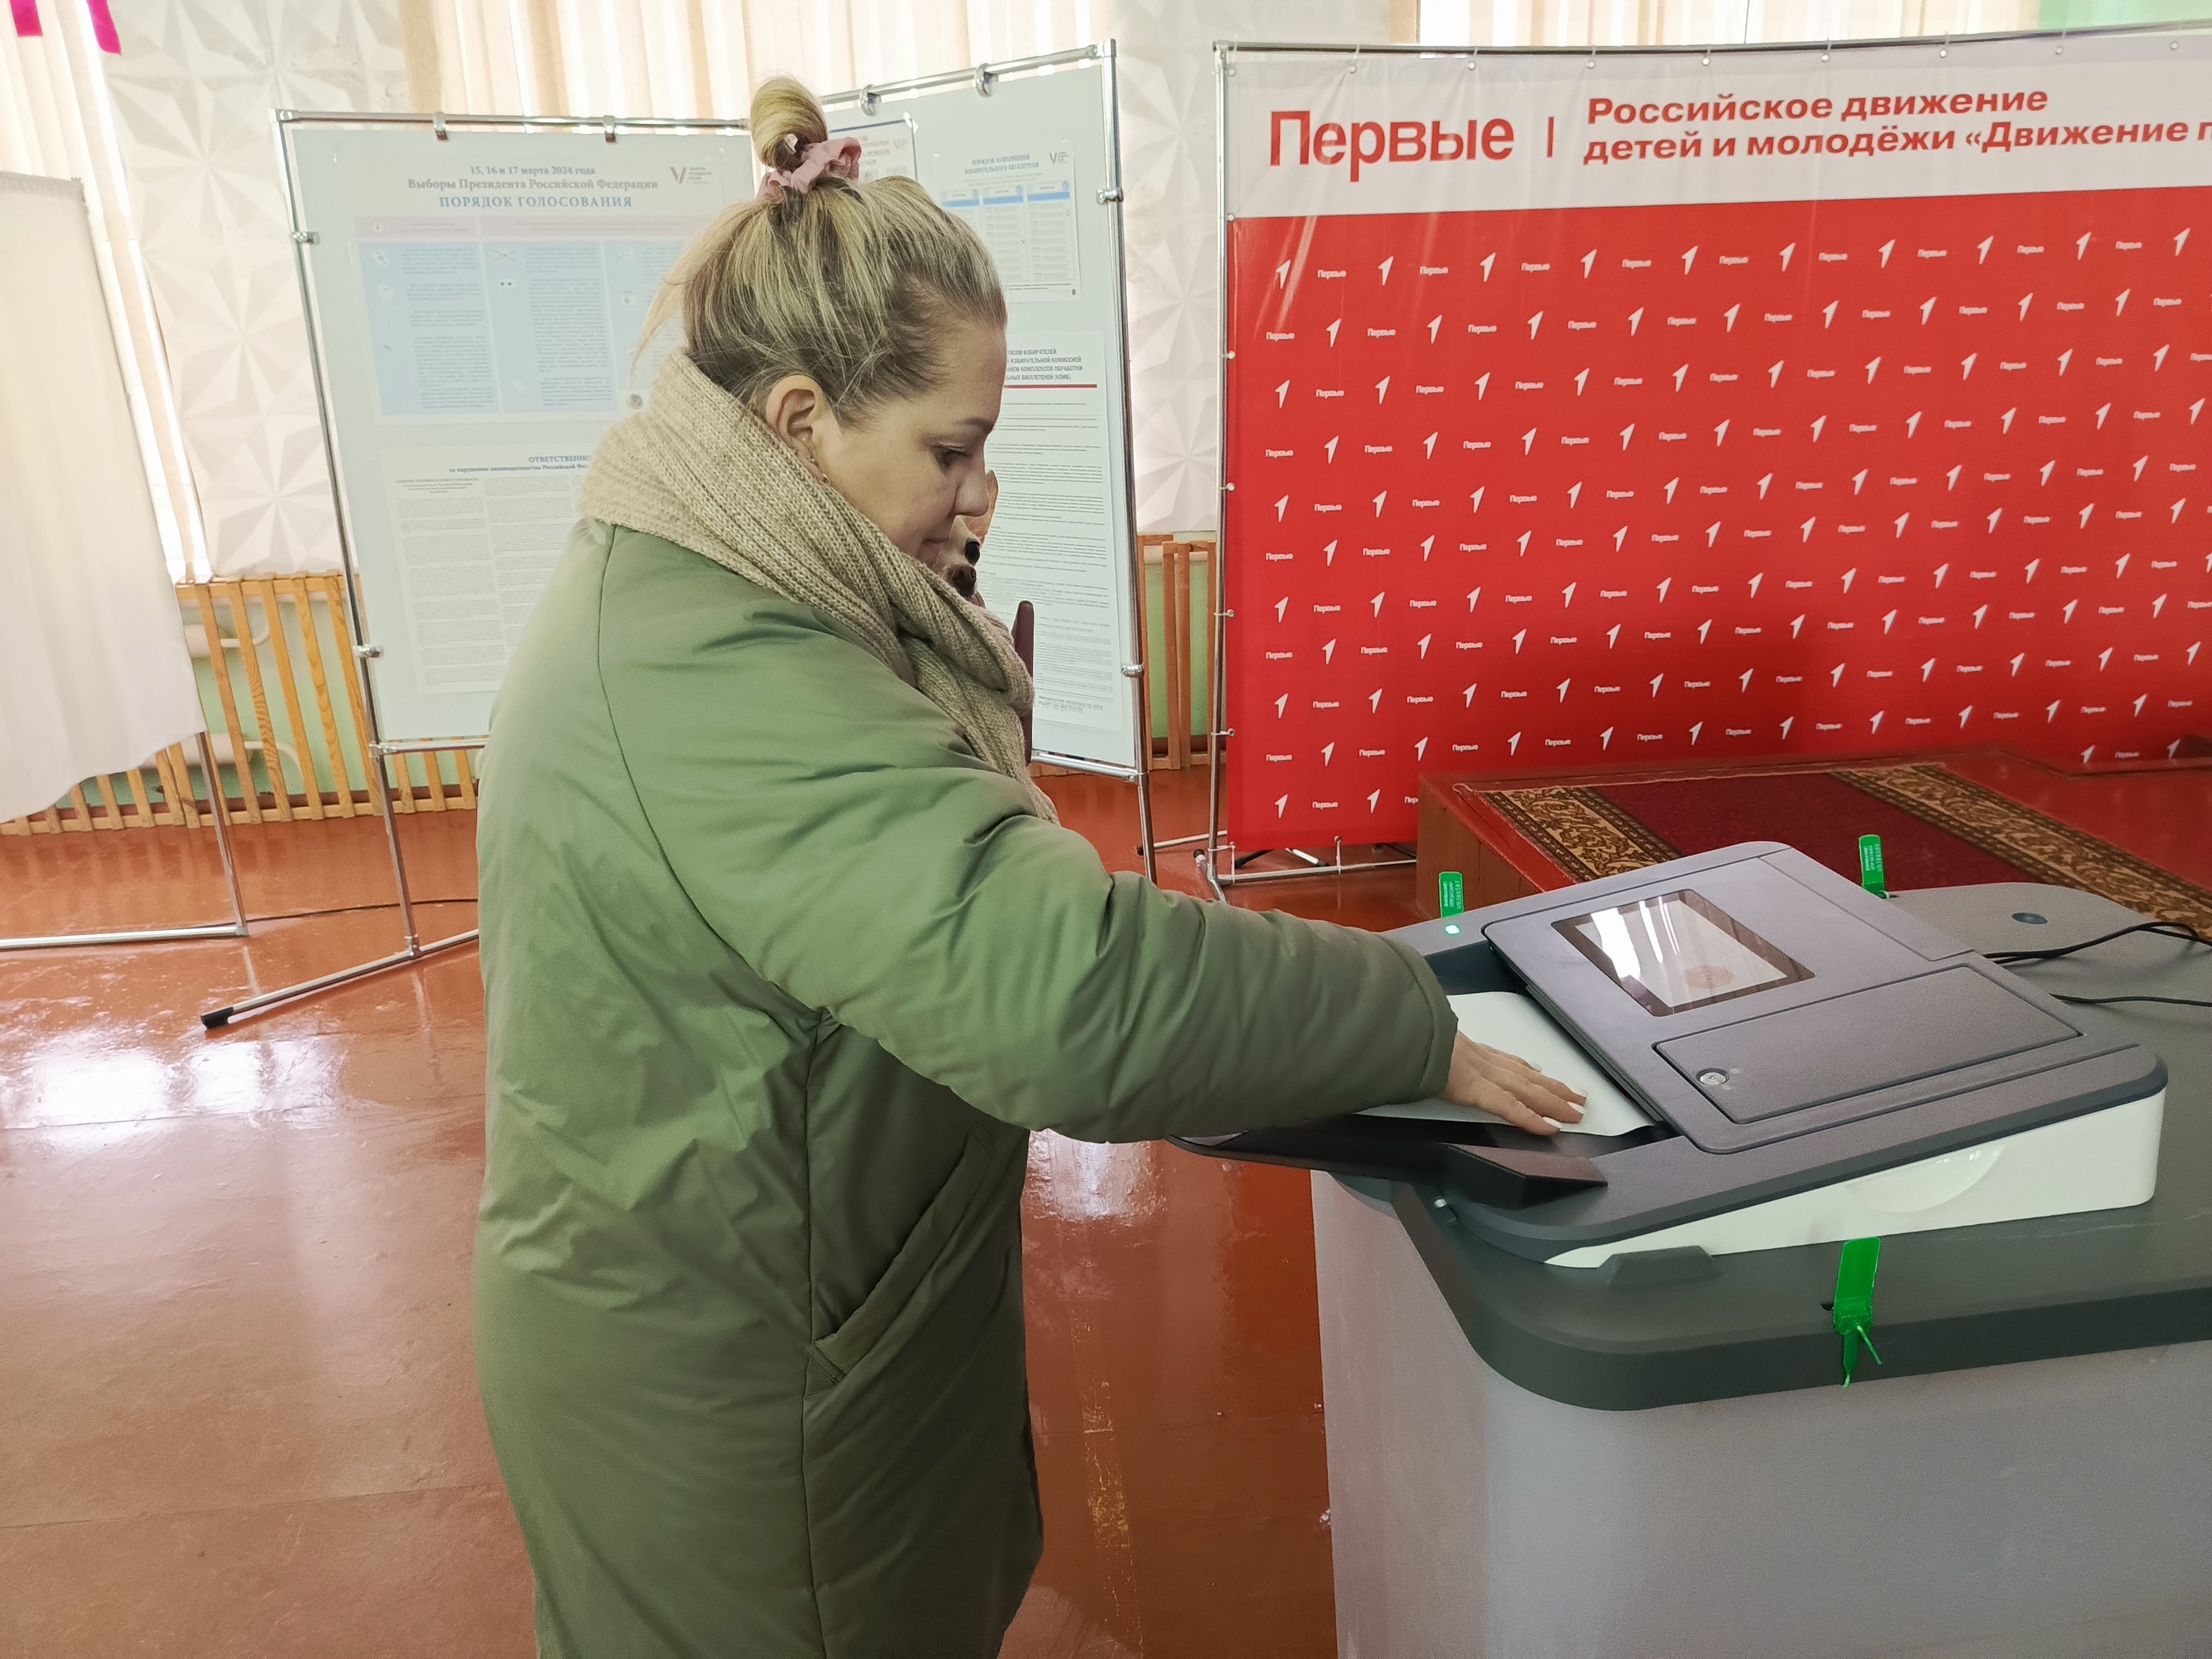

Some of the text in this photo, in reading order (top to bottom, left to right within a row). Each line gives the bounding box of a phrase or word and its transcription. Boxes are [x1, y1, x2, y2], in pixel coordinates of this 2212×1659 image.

[1588, 90, 2048, 124] Российское движение
[1270, 110, 1515, 183] Первые
[1583, 130, 1702, 166] детей
[1713, 137, 1736, 157] и
[1747, 125, 1955, 157] молодёжи
[1965, 121, 2189, 153] «Движение
[470, 166, 484, 176] 15,
[521, 167, 549, 176] марта
[408, 178, 658, 191] Выборы Президента Российской Федерации
[439, 196, 633, 208] ПОРЯДОК ГОЛОСОВАНИЯ
[1419, 265, 1448, 276] Первые
[1521, 262, 1550, 273] Первые
[1317, 269, 1346, 280] Первые
[1467, 324, 1497, 334] Первые
[1568, 320, 1597, 331] Первые
[1265, 331, 1295, 342] Первые
[1367, 328, 1396, 338] Первые
[1515, 381, 1544, 391] Первые
[1614, 377, 1643, 387] Первые
[1316, 389, 1344, 399] Первые
[1415, 385, 1444, 395] Первые
[1463, 440, 1491, 450] Первые
[1561, 436, 1589, 446] Первые
[1265, 449, 1294, 458] Первые
[1364, 444, 1393, 454] Первые
[1509, 494, 1537, 504] Первые
[1606, 490, 1634, 499] Первые
[1314, 503, 1342, 513] Первые
[1411, 499, 1440, 508] Первые
[1459, 543, 1487, 552] Первые
[1555, 539, 1583, 547] Первые
[1265, 552, 1293, 561] Первые
[1362, 547, 1390, 557] Первые
[1505, 594, 1532, 604] Первые
[1600, 590, 1627, 599] Первые
[1313, 604, 1341, 614] Первые
[1409, 599, 1437, 609] Первые
[1456, 641, 1483, 650] Первые
[1550, 636, 1577, 645] Первые
[1265, 651, 1293, 660] Первые
[1360, 646, 1388, 655] Первые
[1594, 685, 1621, 694] Первые
[1501, 691, 1527, 699] Первые
[1312, 701, 1340, 709] Первые
[1406, 696, 1433, 705] Первые
[1452, 744, 1478, 752] Первые
[1545, 739, 1571, 747] Первые
[1265, 754, 1292, 763] Первые
[1359, 749, 1385, 758] Первые
[1312, 801, 1338, 809] Первые
[1404, 796, 1418, 804] Пер
